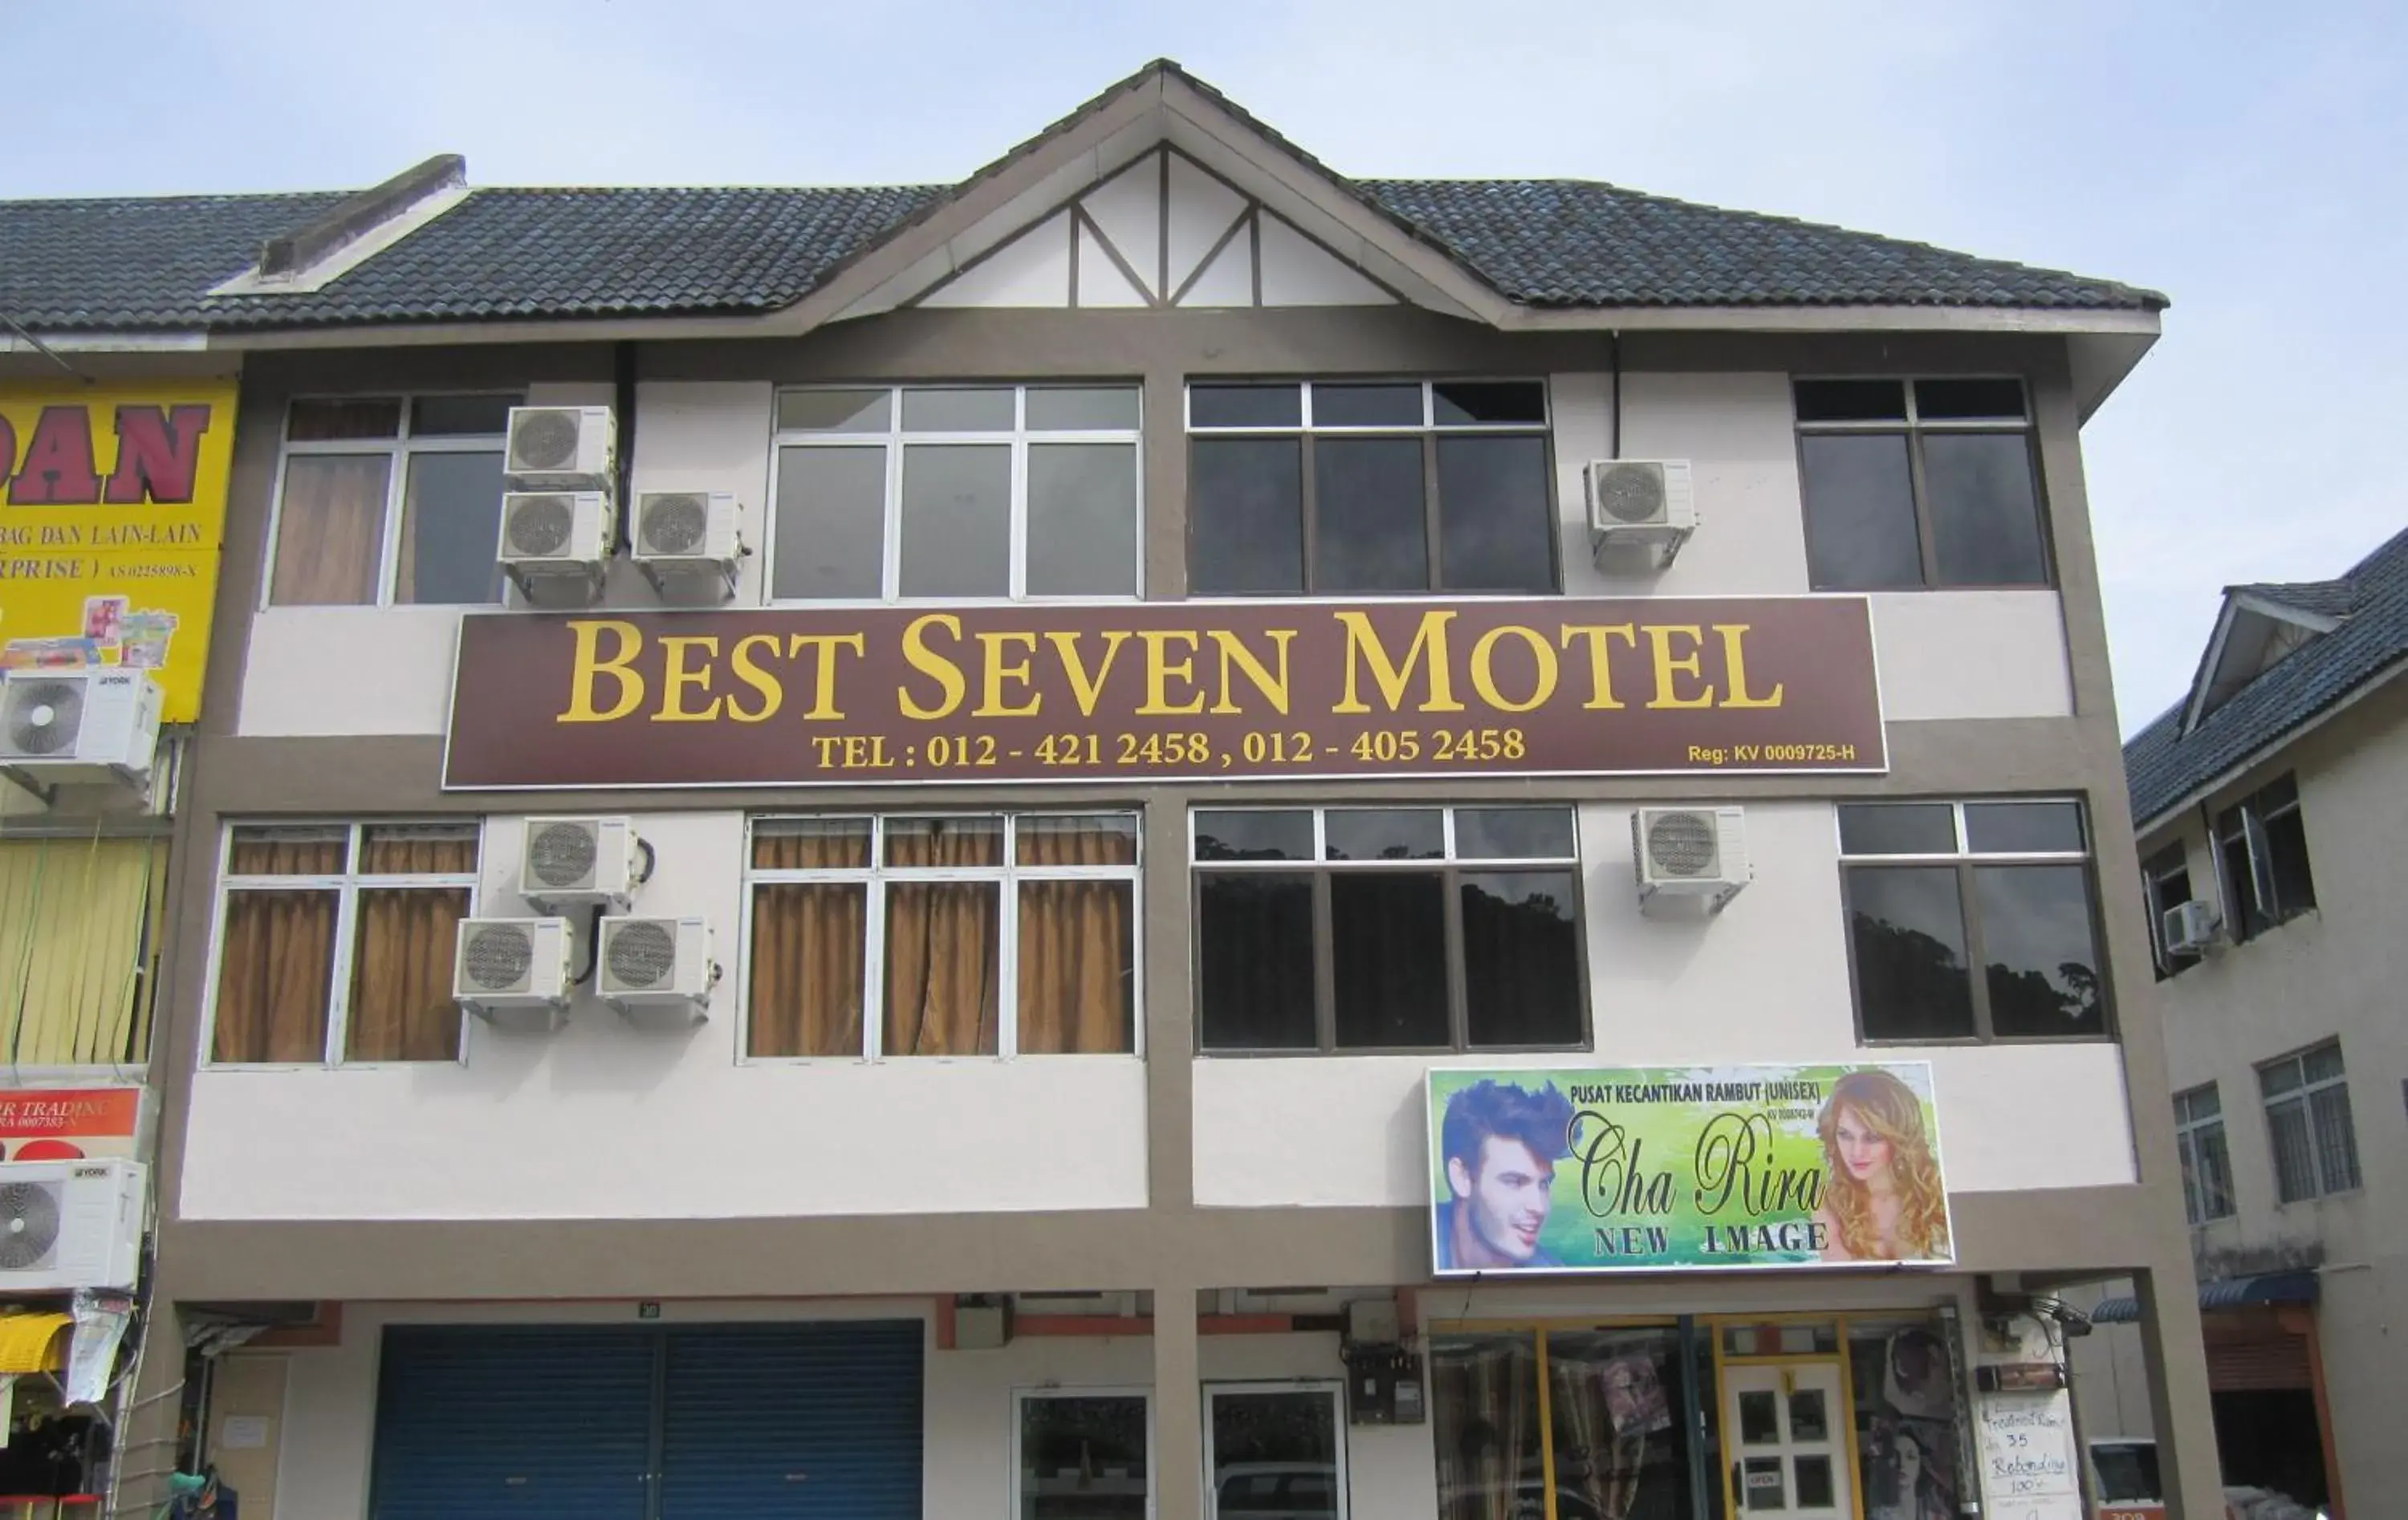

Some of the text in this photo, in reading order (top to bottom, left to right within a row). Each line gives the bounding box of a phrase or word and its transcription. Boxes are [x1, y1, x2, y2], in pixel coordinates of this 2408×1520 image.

[0, 404, 211, 504] AN
[41, 525, 82, 545] DAN
[92, 523, 201, 545] LAIN-LAIN
[555, 609, 1785, 723] BEST SEVEN MOTEL
[926, 734, 997, 766] 012
[1034, 734, 1102, 766] 421
[1117, 731, 1210, 764] 2458
[1243, 730, 1313, 763] 012
[1350, 730, 1420, 762] 405
[1432, 727, 1526, 761] 2458
[1687, 743, 1856, 765] Reg: KV 0009725-H
[1570, 1080, 1820, 1106] PUSAT KECANTIKAN RAMBUT (UNISEX)
[1568, 1110, 1826, 1218] Cha Rira
[1594, 1221, 1829, 1256] NEW IMAGE
